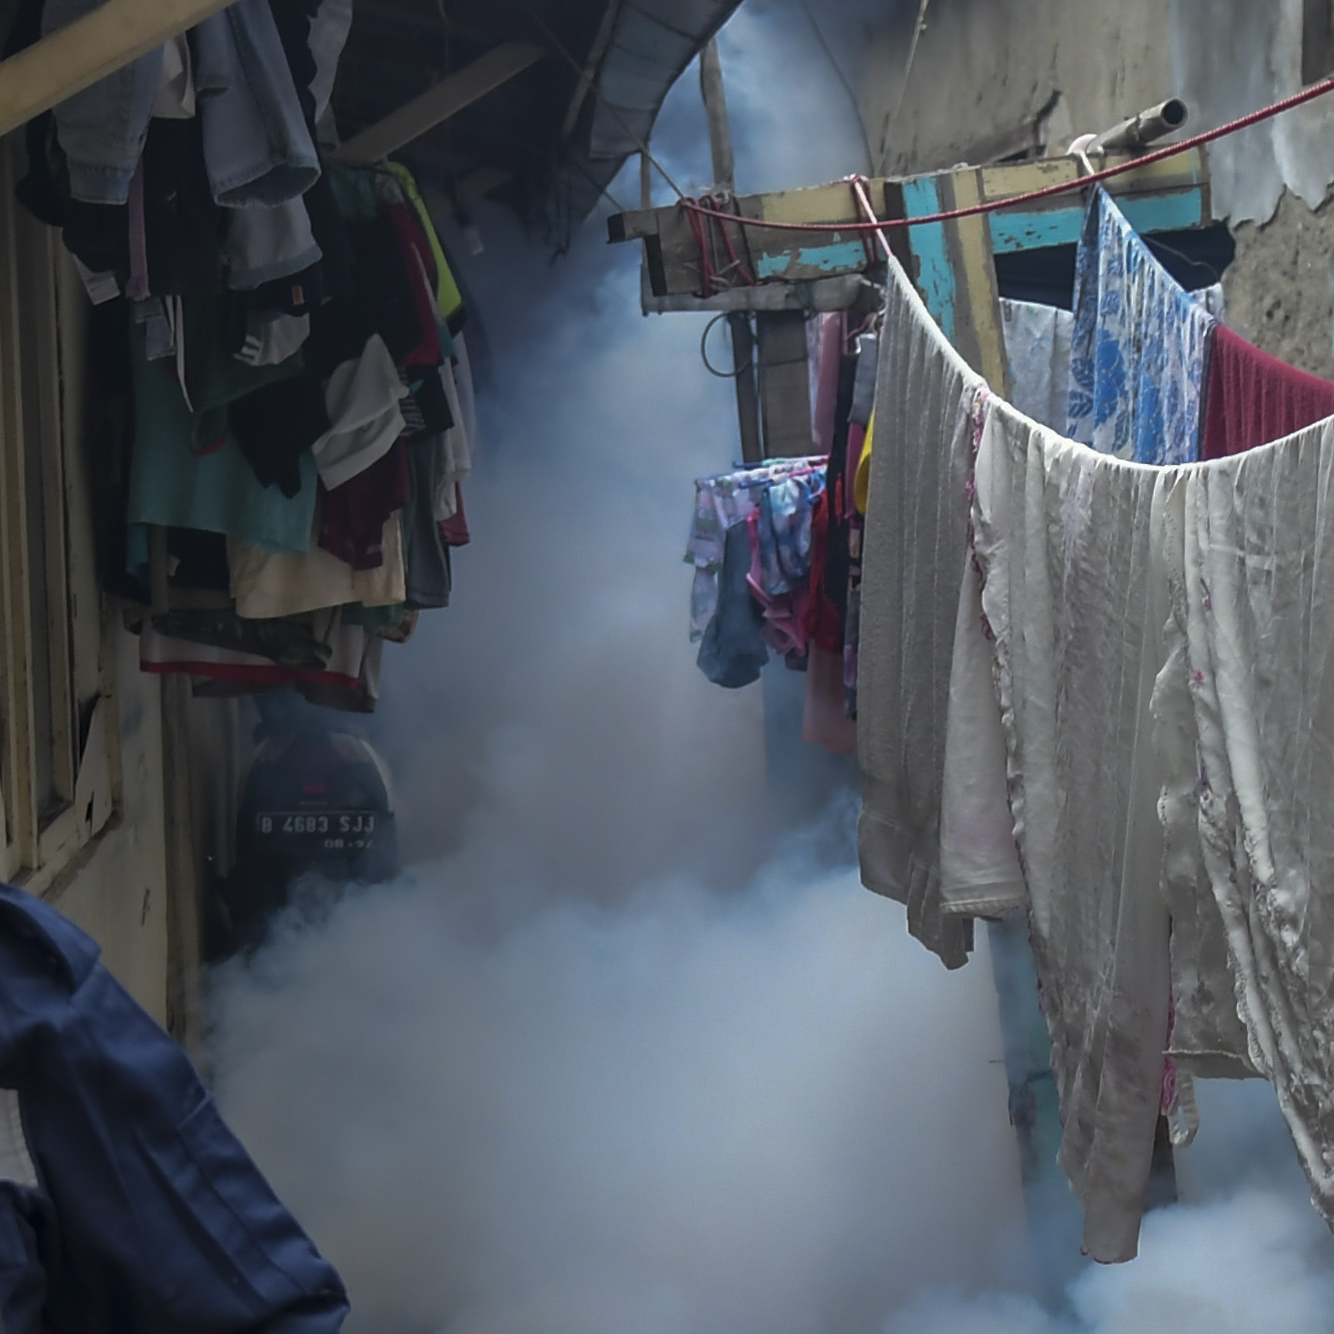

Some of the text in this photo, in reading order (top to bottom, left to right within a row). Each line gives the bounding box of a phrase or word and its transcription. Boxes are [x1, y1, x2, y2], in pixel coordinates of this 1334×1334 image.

[261, 815, 375, 834] B 4683 SJJ
